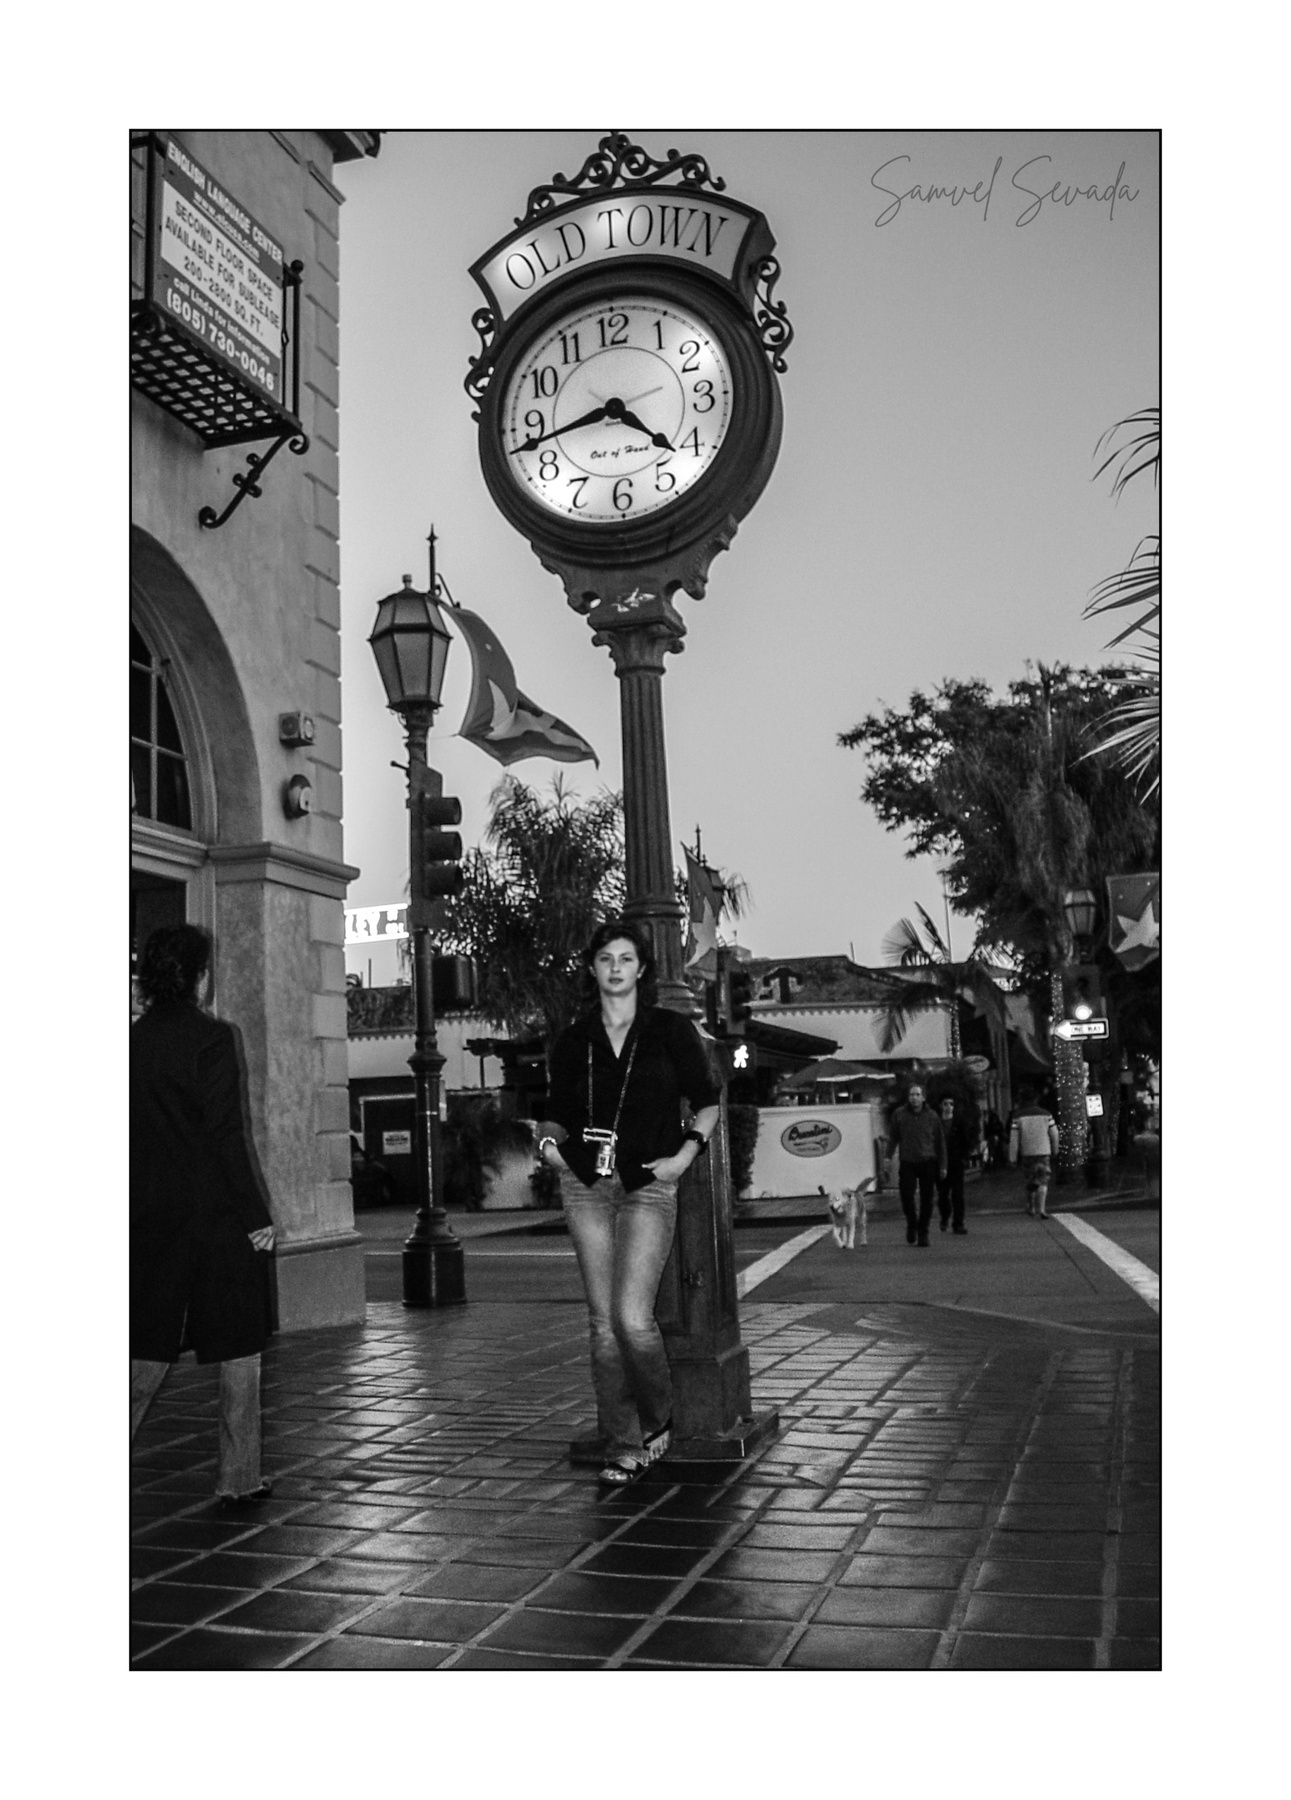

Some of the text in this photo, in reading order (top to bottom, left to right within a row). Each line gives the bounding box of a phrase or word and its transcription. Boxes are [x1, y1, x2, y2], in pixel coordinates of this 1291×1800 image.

[168, 142, 282, 265] ENGLISH LANGUAGE CENTER
[175, 201, 273, 301] SECOND FLOOR SPACE
[505, 204, 729, 290] OLD TOWN
[165, 216, 280, 329] AVAILABLE FOR SUBLEASE
[167, 288, 274, 391] (805) 730-0046
[191, 289, 213, 317] Linda
[227, 320, 270, 365] information
[596, 313, 629, 348] 12
[653, 320, 664, 350] 1
[560, 332, 585, 365] 11
[679, 340, 701, 373] 2
[530, 366, 559, 399] 10
[693, 380, 715, 413] 3
[524, 410, 545, 443] 9
[680, 426, 705, 457] 4
[539, 450, 560, 480] 8
[590, 450, 607, 459] Out
[611, 448, 620, 458] of
[655, 456, 676, 492] 5
[566, 476, 589, 509] 7
[612, 478, 633, 511] 6
